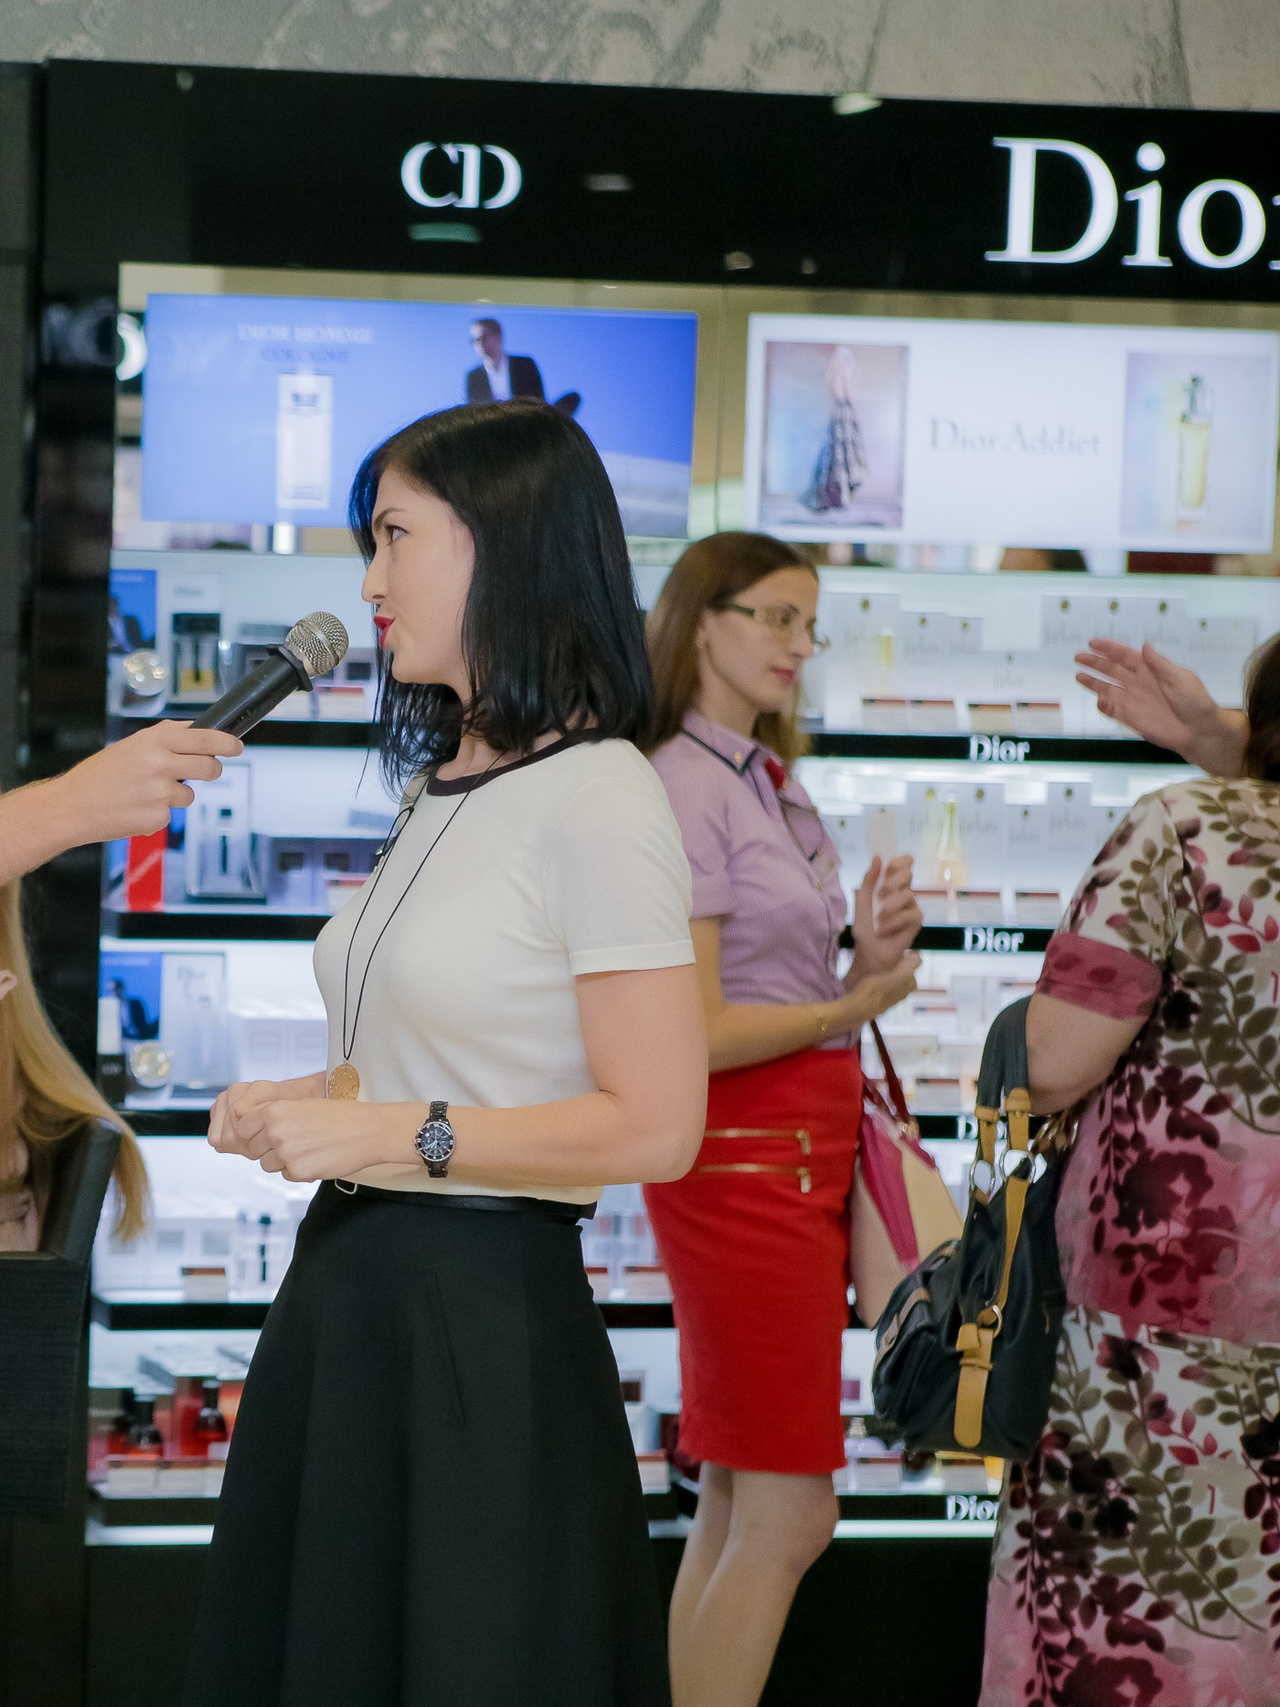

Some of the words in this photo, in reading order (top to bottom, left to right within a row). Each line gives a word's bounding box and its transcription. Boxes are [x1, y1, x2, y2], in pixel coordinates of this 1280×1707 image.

[984, 136, 1280, 271] Dio
[929, 417, 999, 455] Dior
[1003, 420, 1102, 457] Addict
[969, 734, 1030, 763] Dior
[964, 926, 1025, 953] Dior
